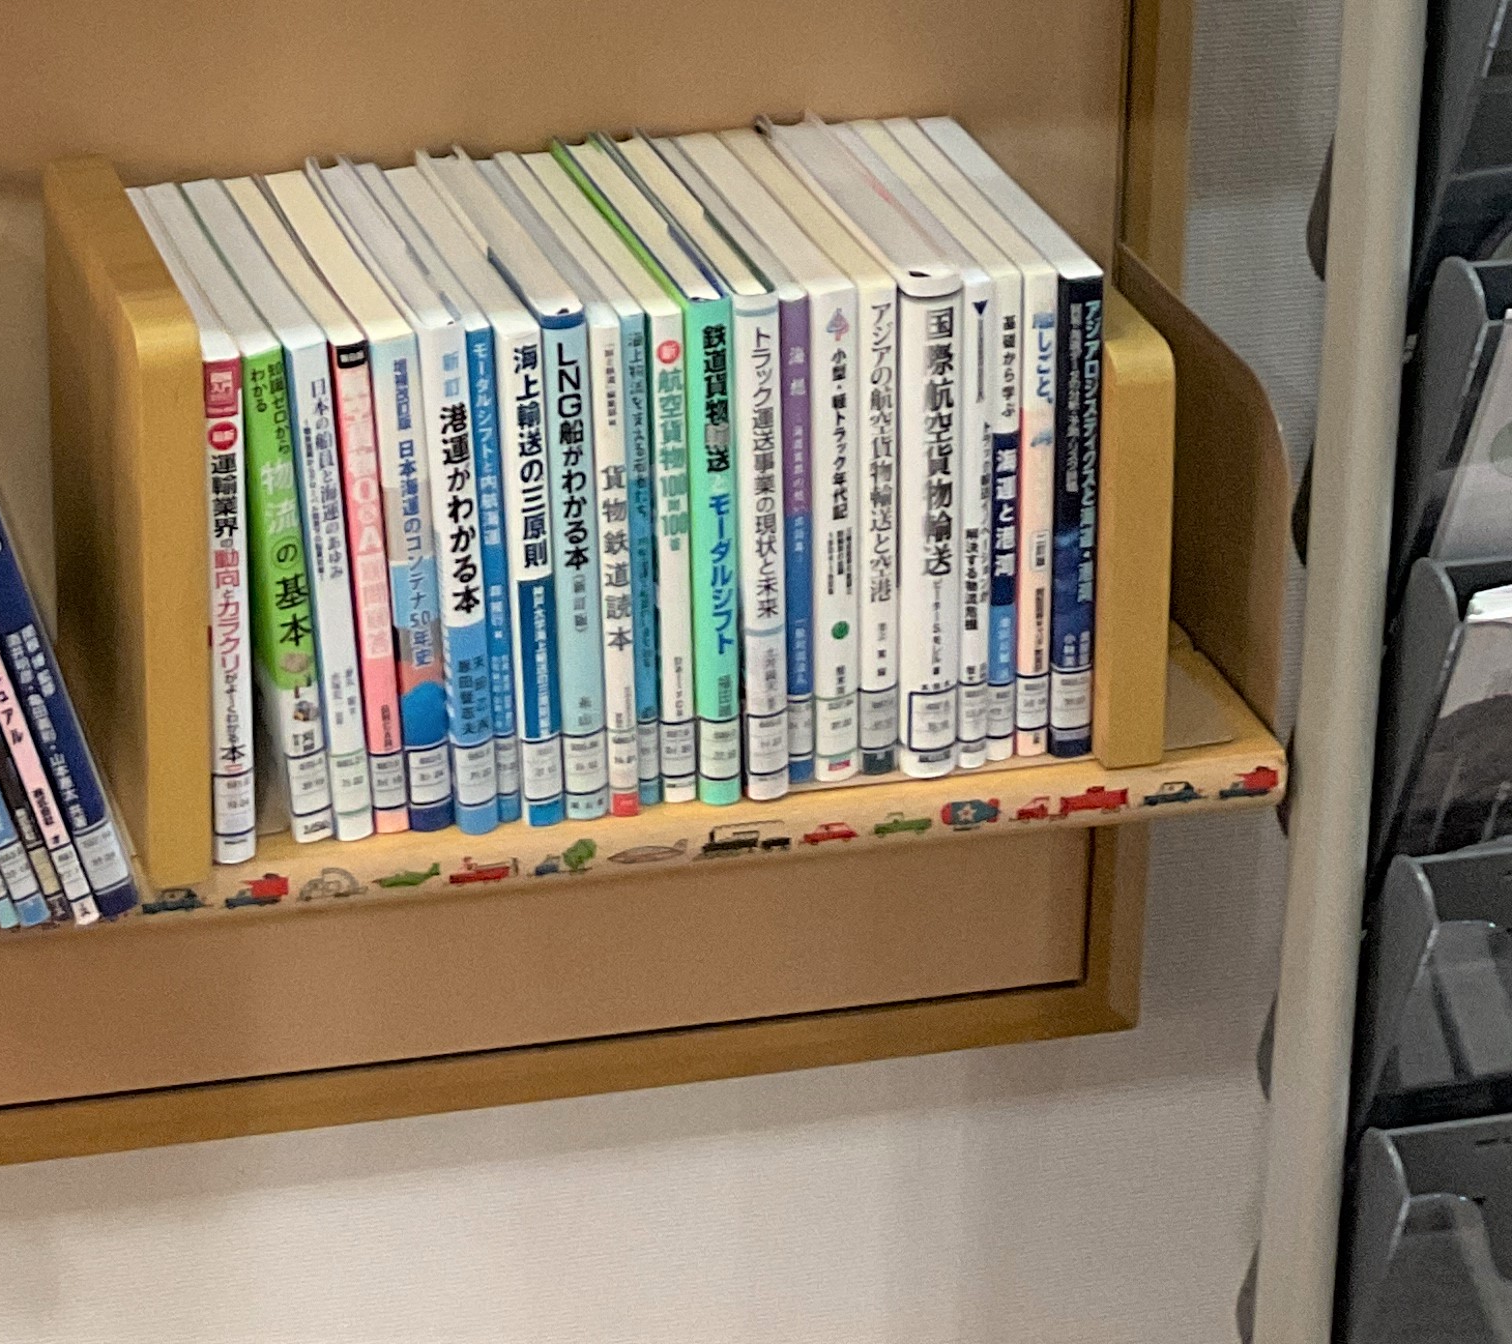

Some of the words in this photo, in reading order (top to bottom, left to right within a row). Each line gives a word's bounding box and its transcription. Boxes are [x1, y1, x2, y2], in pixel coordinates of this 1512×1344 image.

[439, 401, 481, 616] 港運がわかる本
[512, 342, 549, 570] 海上輸送の三原則
[555, 340, 590, 572] LNG船がわかる本
[599, 463, 634, 653] 貨物鉄道読本
[702, 322, 737, 655] 鉄道貨物輸送とモーダルシフト
[750, 326, 781, 620] トラック運送事業の現状と未来
[869, 301, 895, 604] アジアの航空貨物輸送と空港
[923, 304, 956, 577] 国際航空貨物輸送
